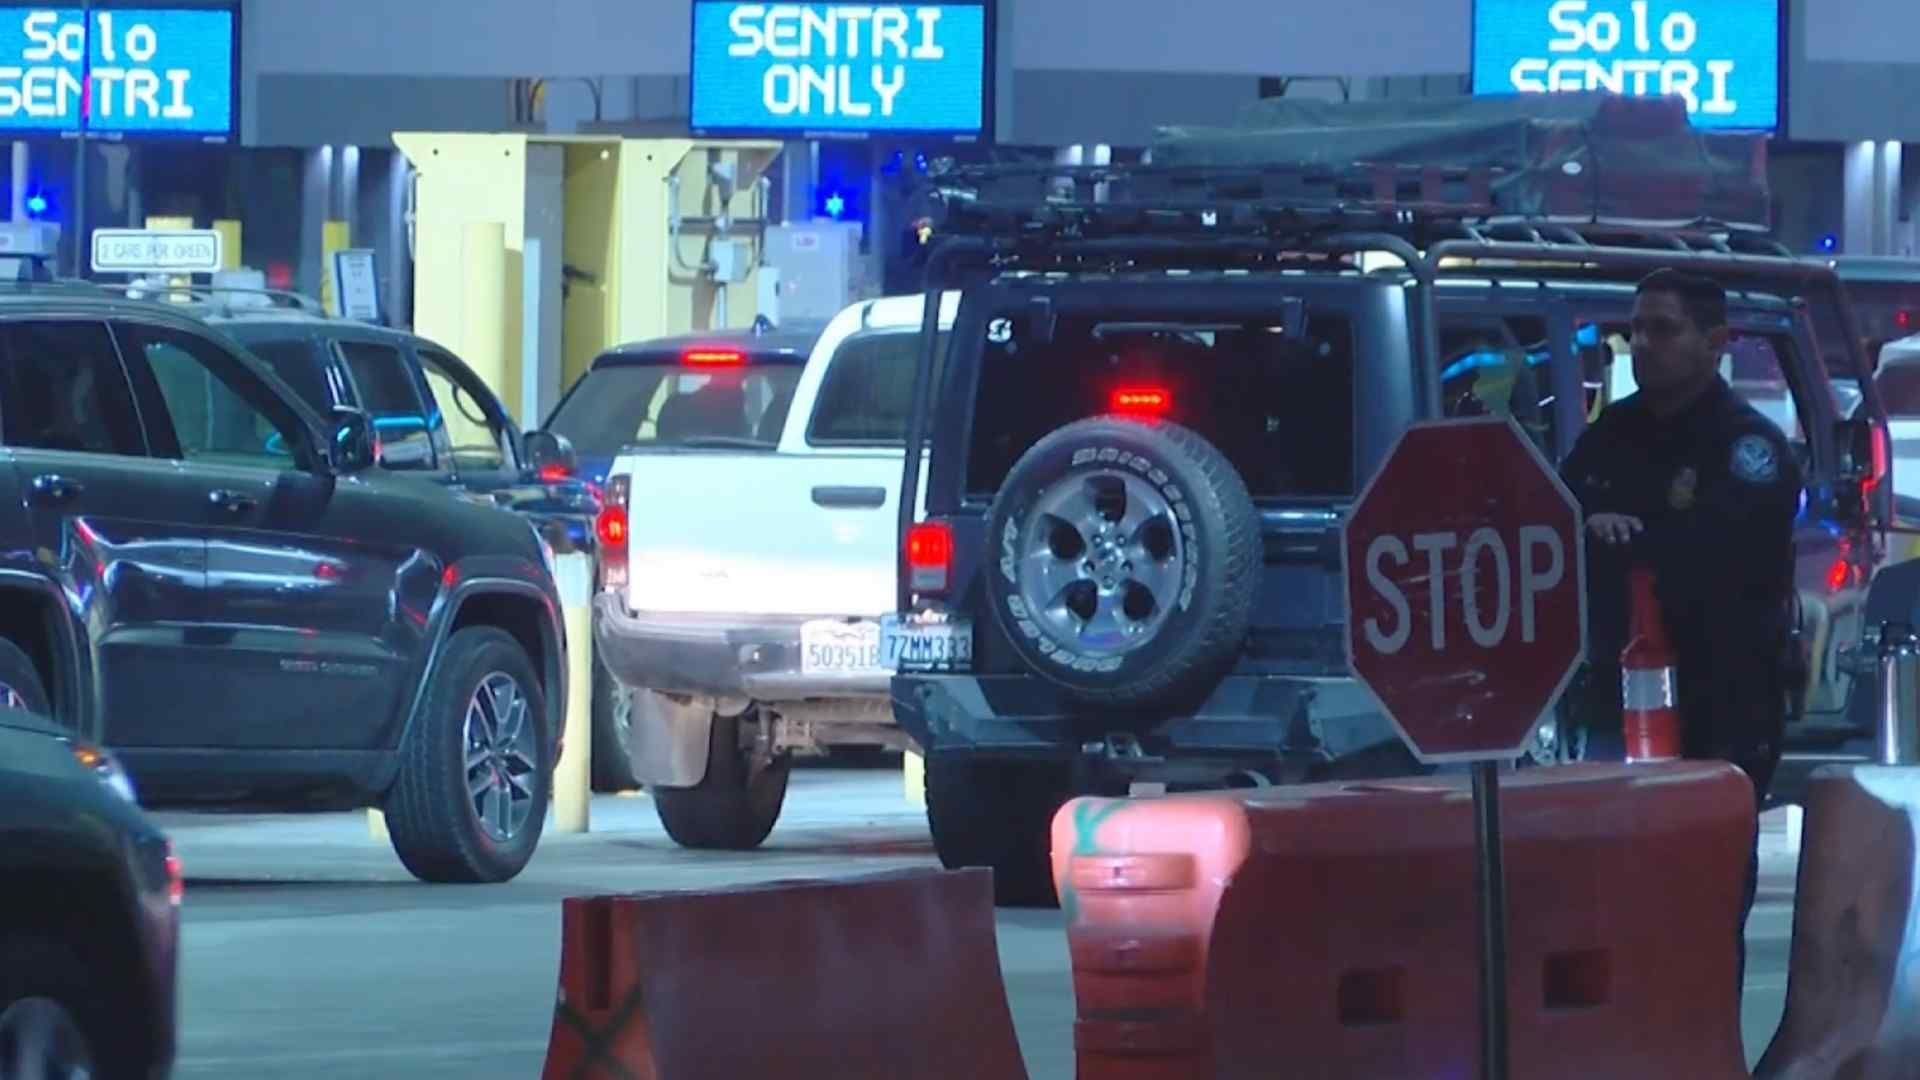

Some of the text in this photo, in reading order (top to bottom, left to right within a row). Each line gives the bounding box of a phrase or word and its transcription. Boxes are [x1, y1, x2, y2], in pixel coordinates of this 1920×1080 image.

[22, 11, 157, 62] Solo
[728, 6, 944, 59] SENTRI
[1548, 0, 1697, 52] Solo
[0, 66, 194, 118] SENTRI
[762, 63, 905, 116] ONLY
[1510, 58, 1738, 113] SENTRI
[1364, 525, 1565, 654] STOP
